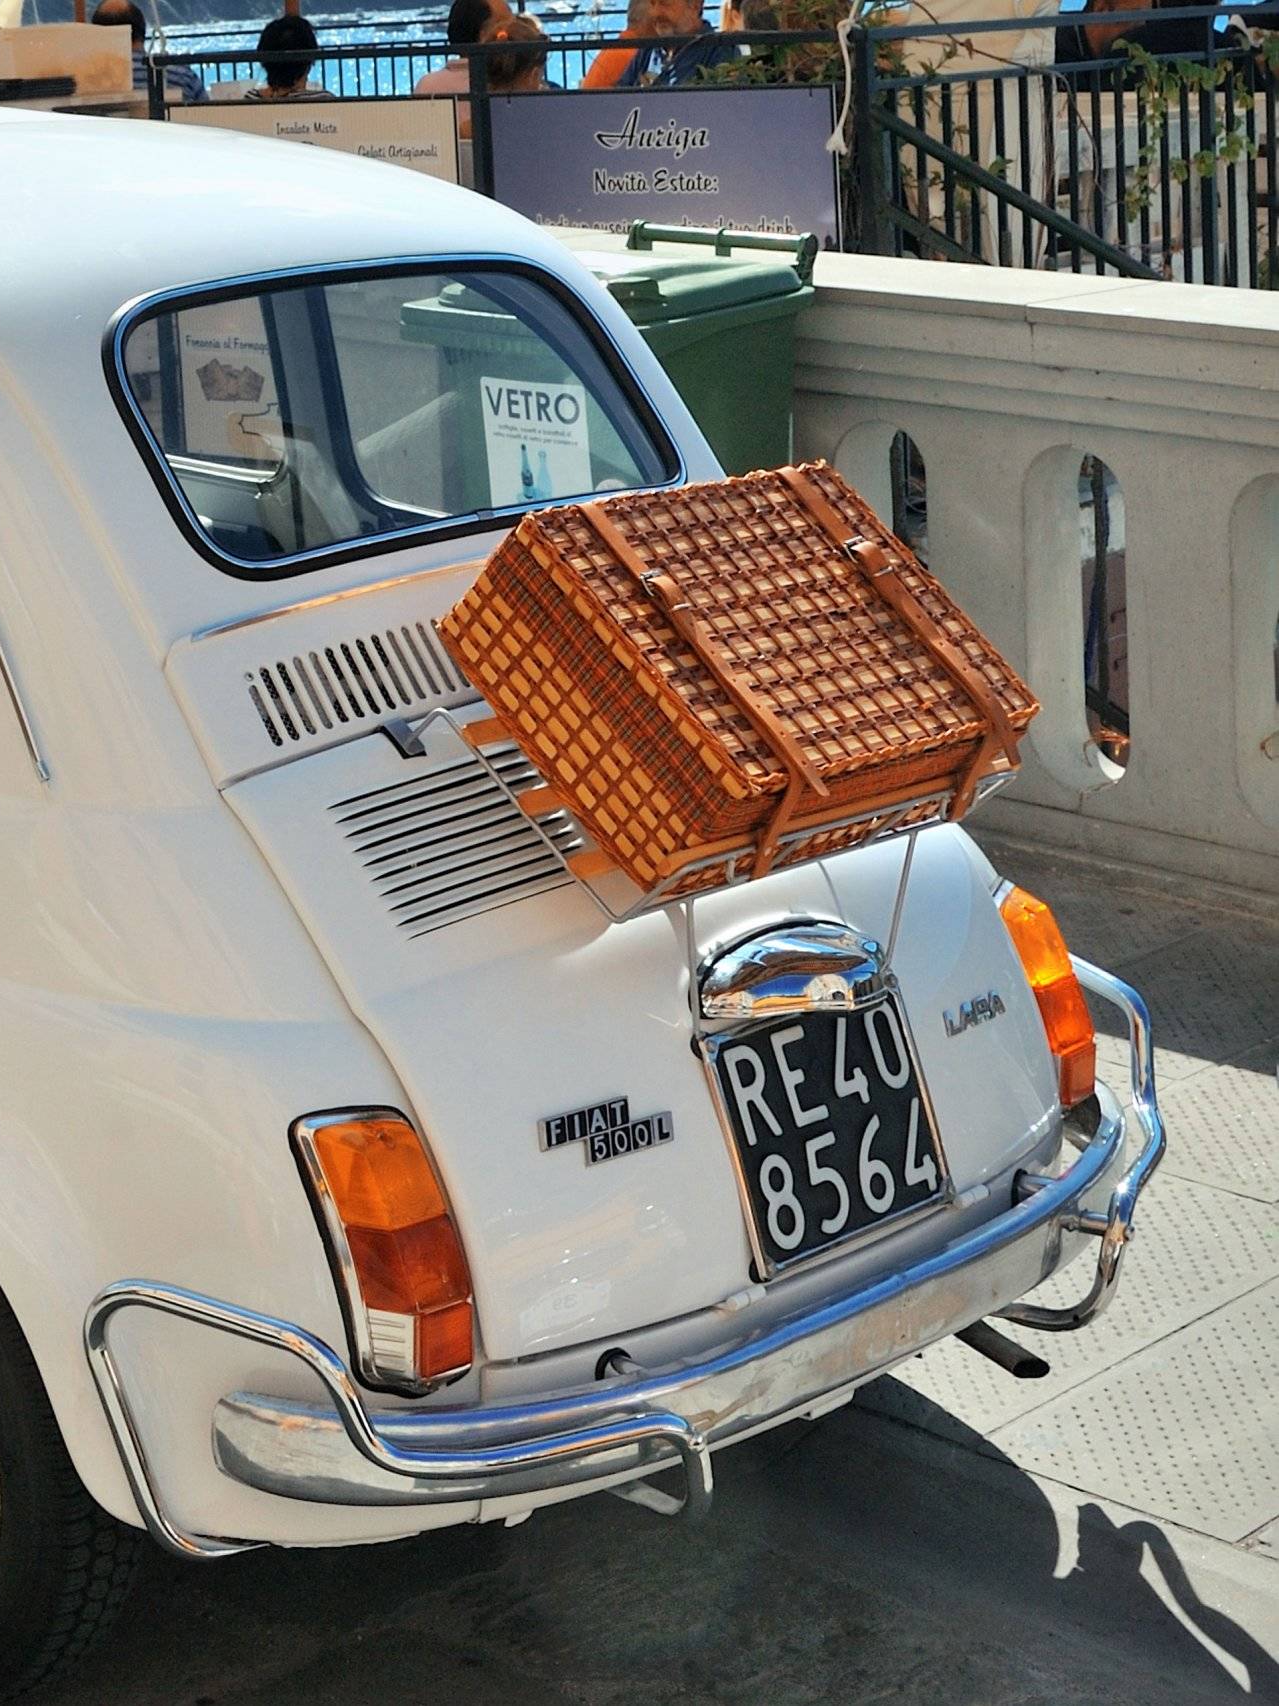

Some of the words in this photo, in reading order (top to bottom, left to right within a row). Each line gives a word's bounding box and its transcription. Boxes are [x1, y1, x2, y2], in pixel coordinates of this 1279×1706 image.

[388, 144, 438, 161] Artigianali
[595, 107, 709, 158] Auriga
[593, 168, 648, 194] Novità
[653, 167, 719, 194] Estate:
[485, 385, 580, 425] VETRO
[548, 1100, 626, 1146] FIAT
[592, 1115, 671, 1160] 500L
[759, 1096, 938, 1251] 8564
